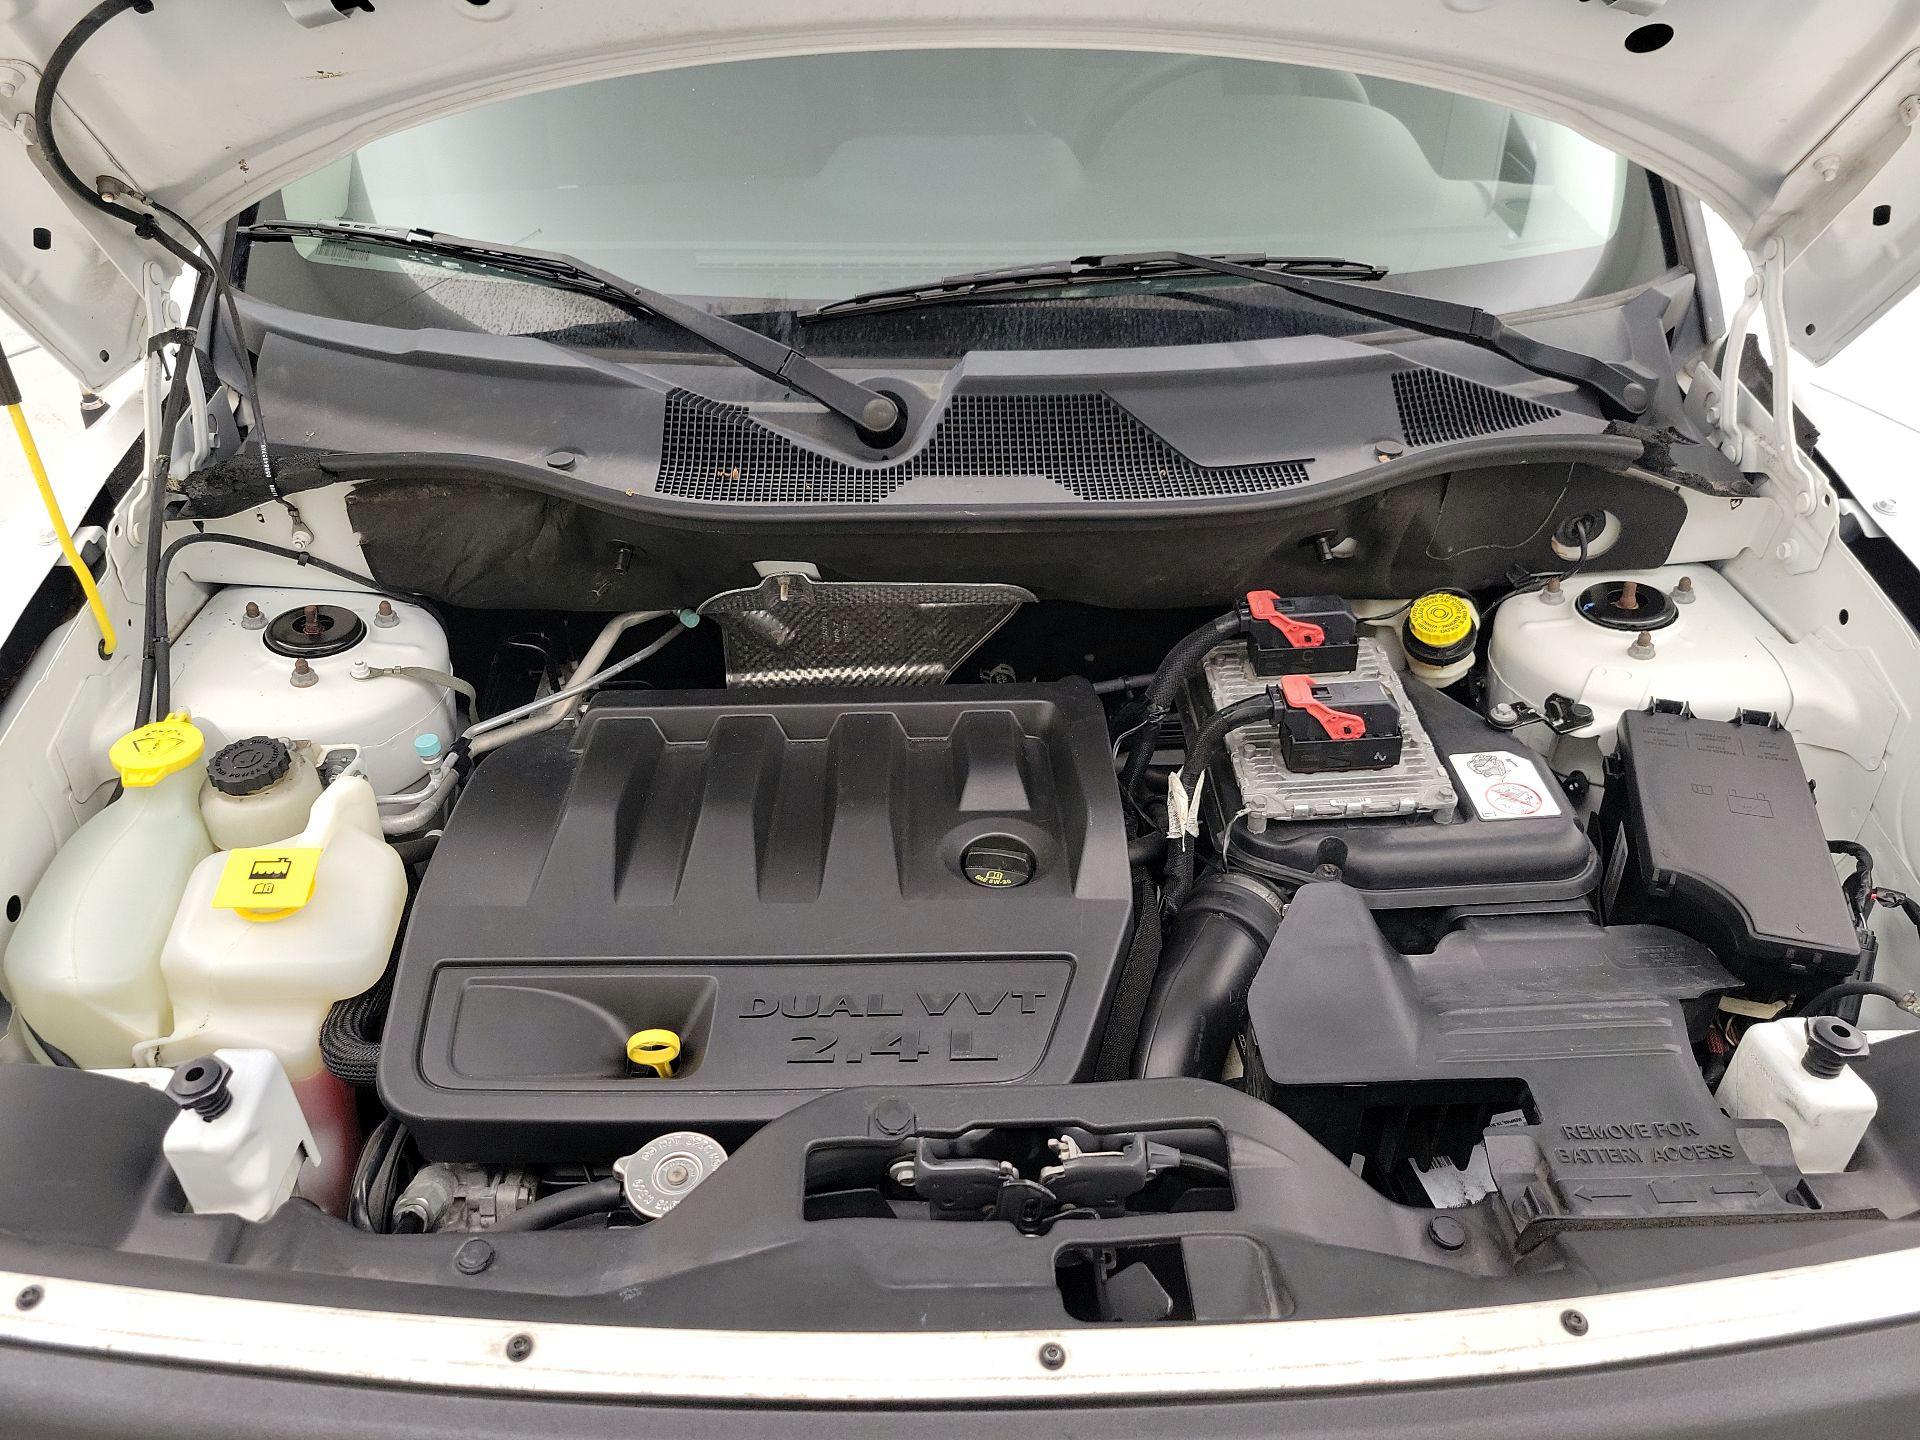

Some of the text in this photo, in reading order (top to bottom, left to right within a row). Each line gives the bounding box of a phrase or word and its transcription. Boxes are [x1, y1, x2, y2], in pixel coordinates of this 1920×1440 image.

[739, 991, 1046, 1018] DUAL VVT
[1561, 1121, 1700, 1140] REMOVE FOR
[658, 1136, 682, 1149] NOT
[1556, 1144, 1735, 1164] BATTERY ACCESS
